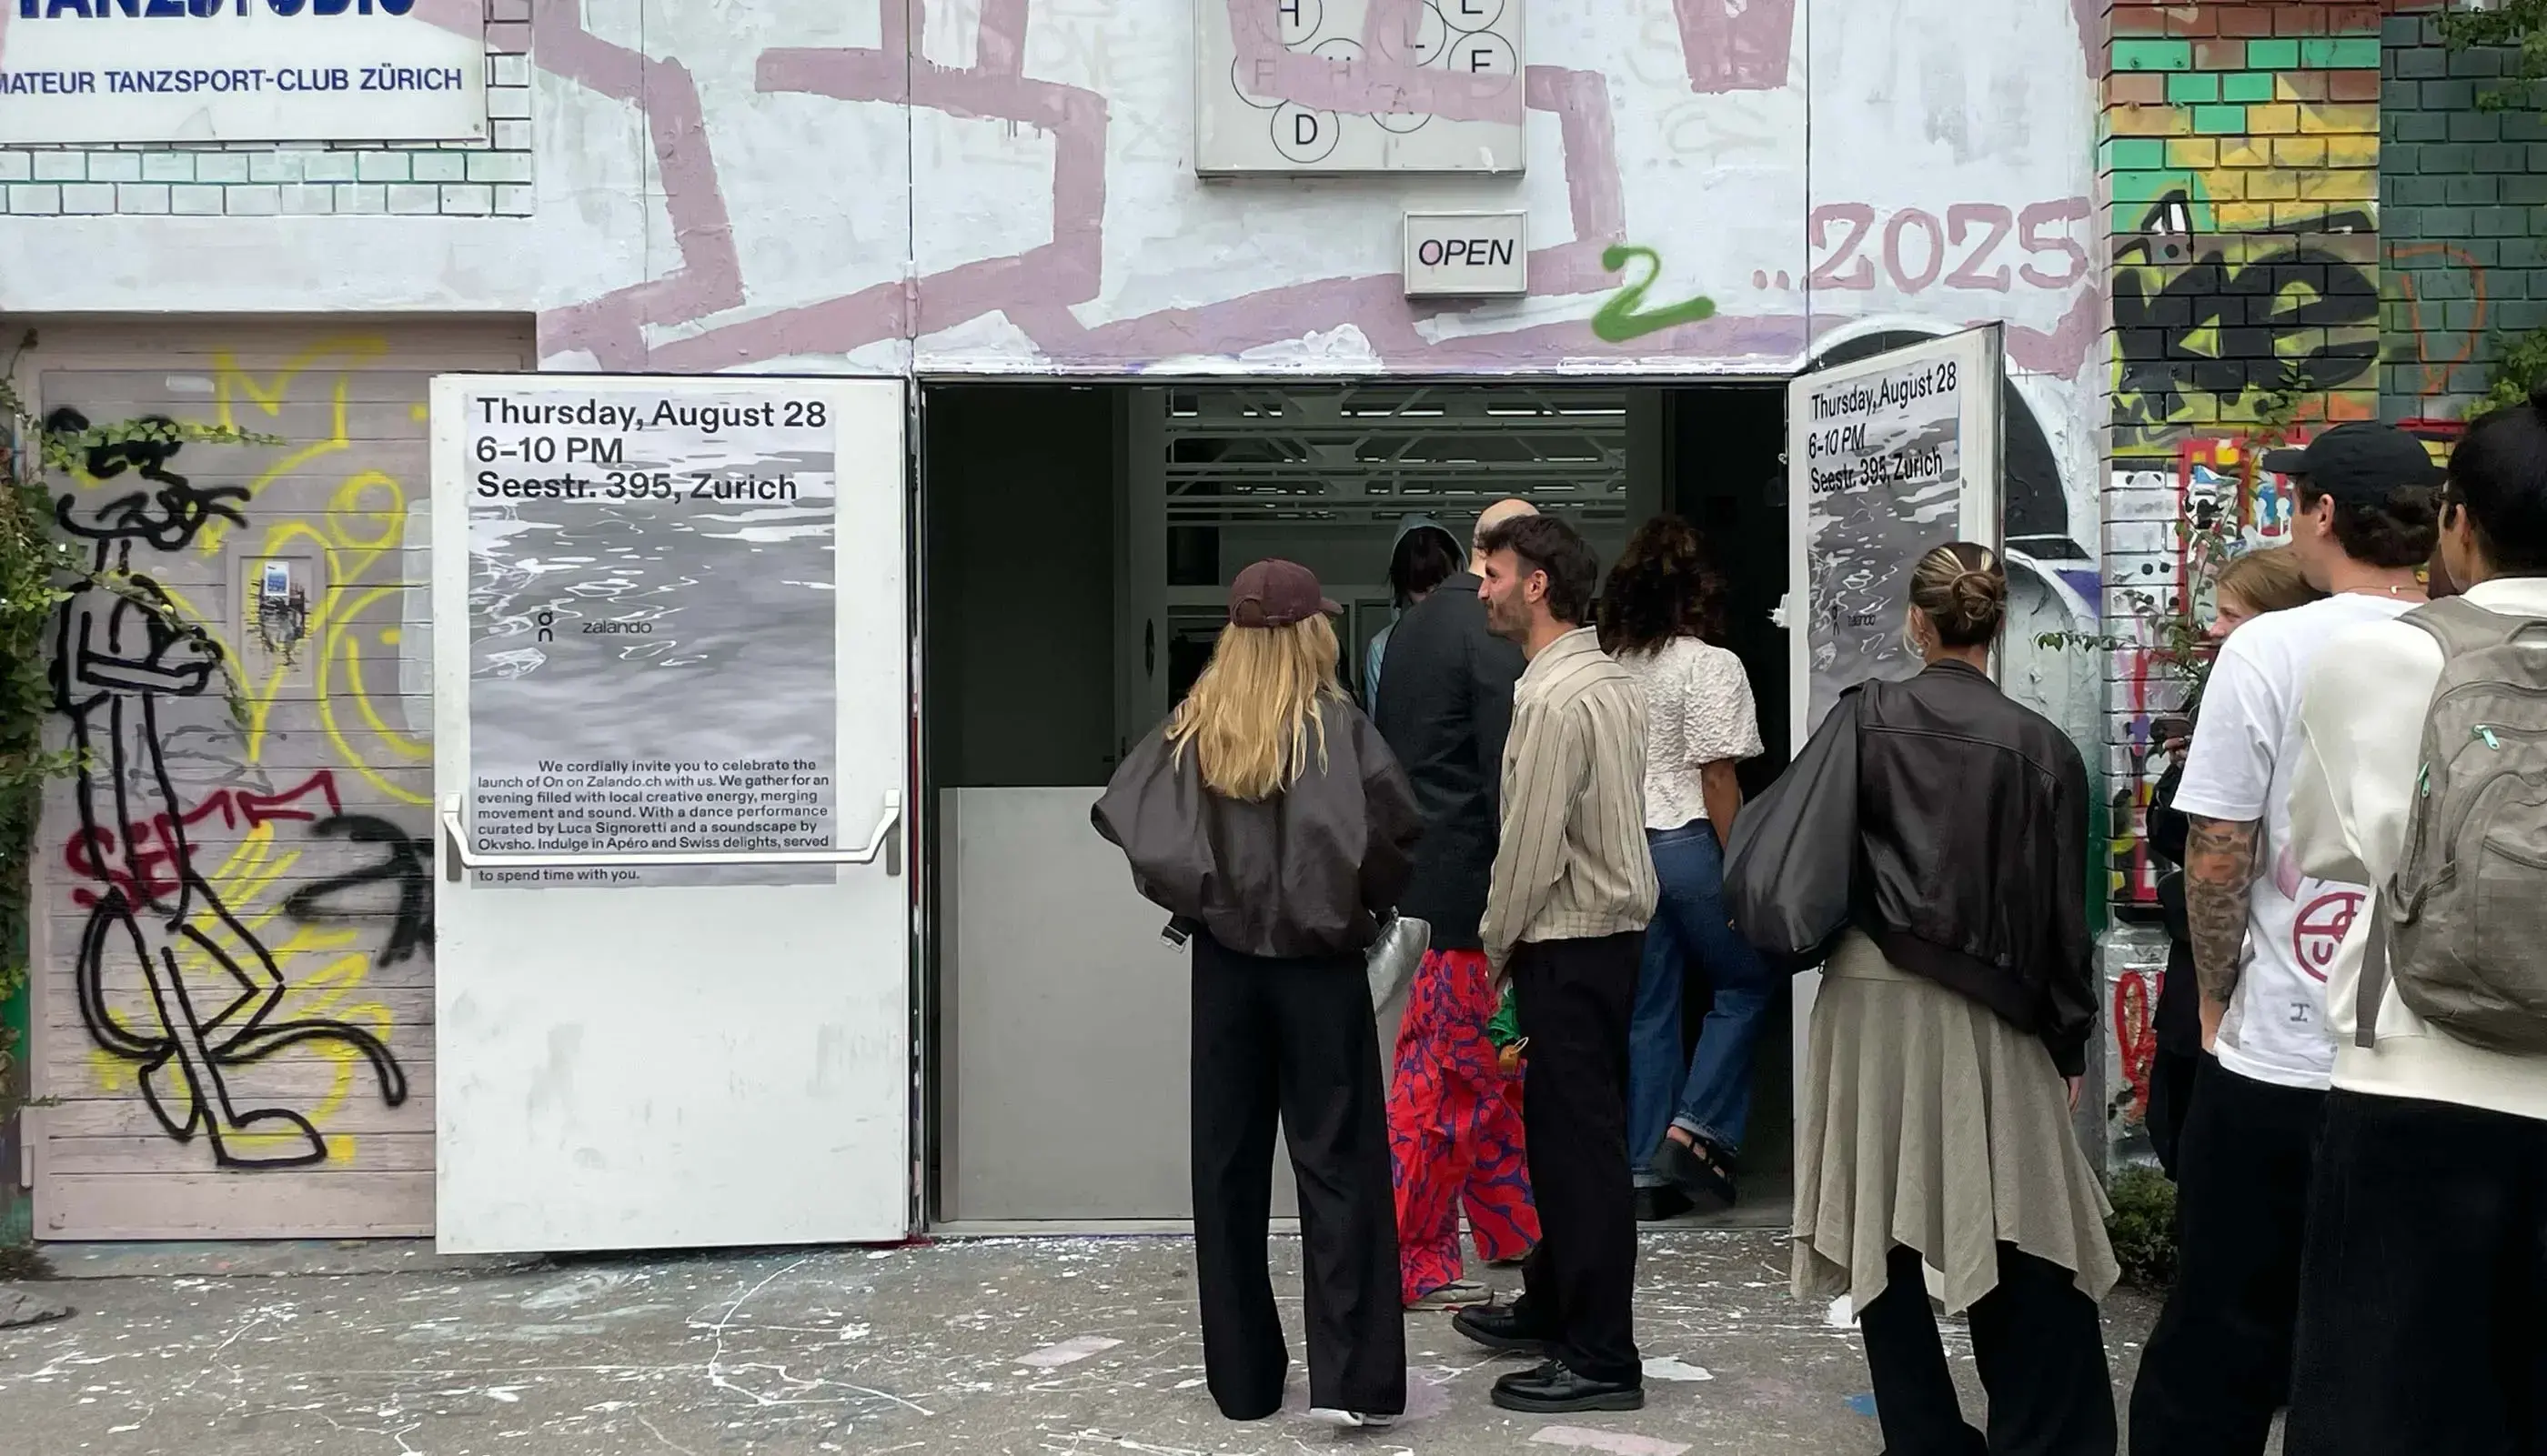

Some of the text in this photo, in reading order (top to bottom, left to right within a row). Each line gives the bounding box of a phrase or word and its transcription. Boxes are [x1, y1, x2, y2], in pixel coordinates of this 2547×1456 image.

[105, 68, 349, 93] TANZSPORT-CLUB
[360, 63, 462, 91] ZÜRICH
[1295, 114, 1318, 146] D
[1418, 238, 1515, 266] OPEN
[1811, 361, 1958, 420] Thursday, August 28
[476, 397, 827, 434] Thursday, August 28
[566, 437, 623, 464] PM
[1841, 423, 1867, 452] PM
[1810, 447, 1943, 494] Seestr. 395, Zurich
[476, 470, 798, 505] Seestr. 395, Zurich
[582, 620, 652, 634] zalando
[538, 758, 817, 773] We cordially invite you to celebrate the
[478, 774, 830, 788] launch of On on Zalando.ch with us. We gather for an
[477, 790, 818, 805] evening filled with local creative energy, merging
[478, 805, 828, 819] movement and sound. With a dance performance
[478, 820, 818, 835] curated by Luca Signoretti and a soundscape by
[538, 837, 590, 852] Indulge
[591, 837, 605, 849] in
[606, 837, 649, 851] Apéro
[651, 837, 678, 848] and
[679, 836, 720, 848] Swiss
[722, 836, 781, 850] delights,
[783, 835, 829, 847] served
[479, 869, 641, 882] to spend time with you.
